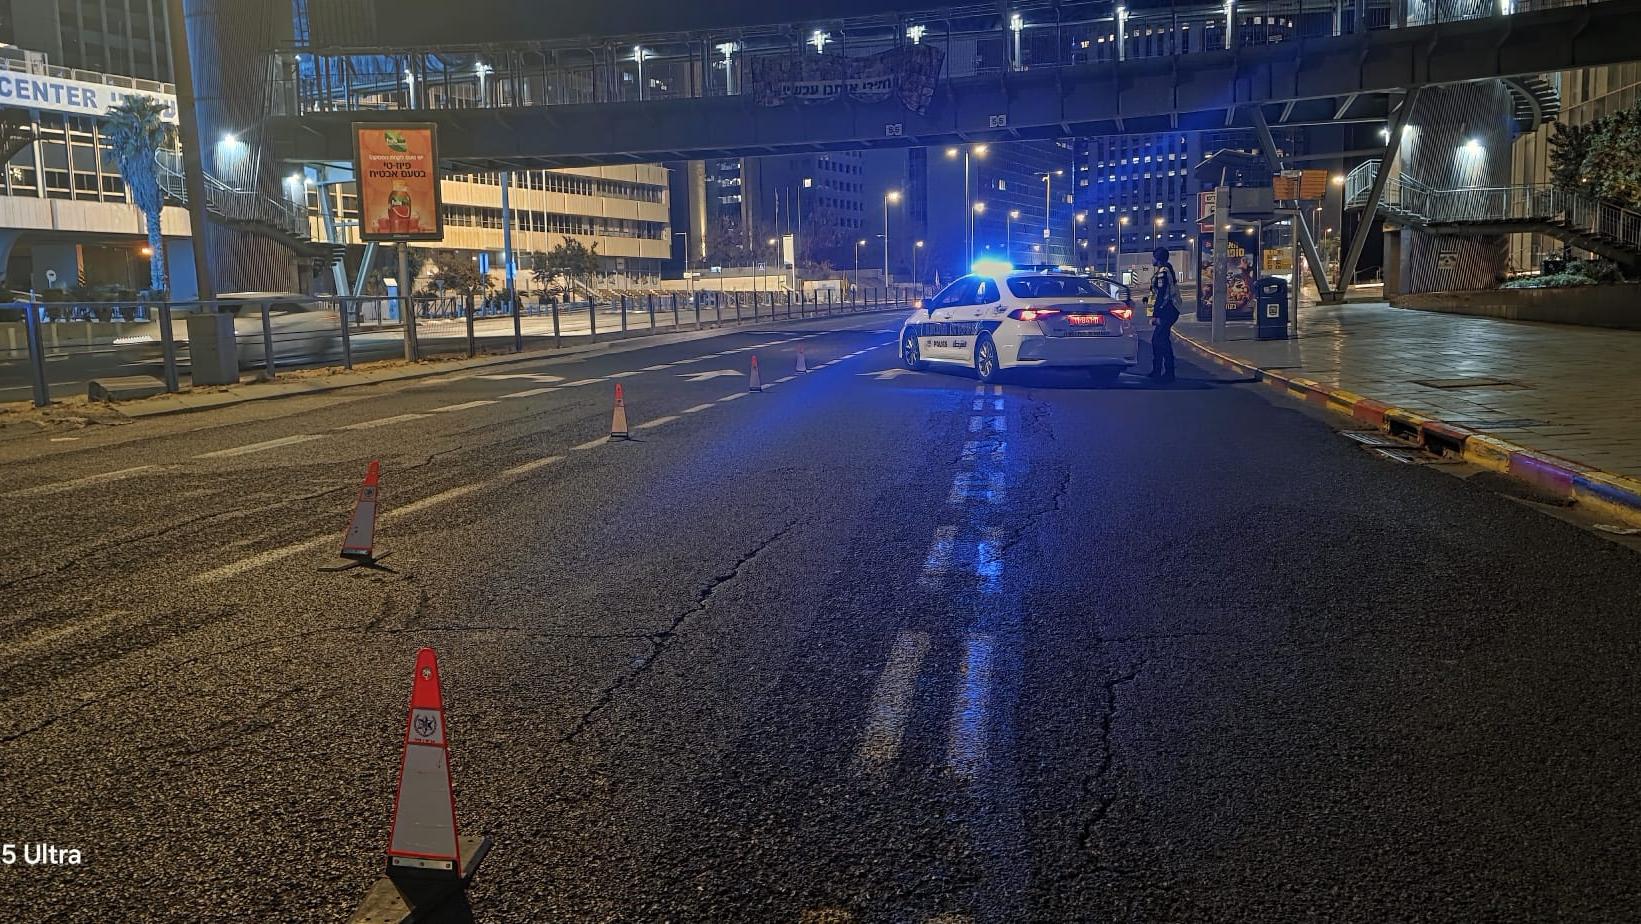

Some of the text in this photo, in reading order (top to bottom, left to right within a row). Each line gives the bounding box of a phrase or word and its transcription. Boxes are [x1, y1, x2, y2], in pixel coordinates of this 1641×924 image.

[0, 76, 98, 109] CENTER
[369, 170, 426, 178] בטעם אבטיח
[933, 340, 948, 348] POLICE
